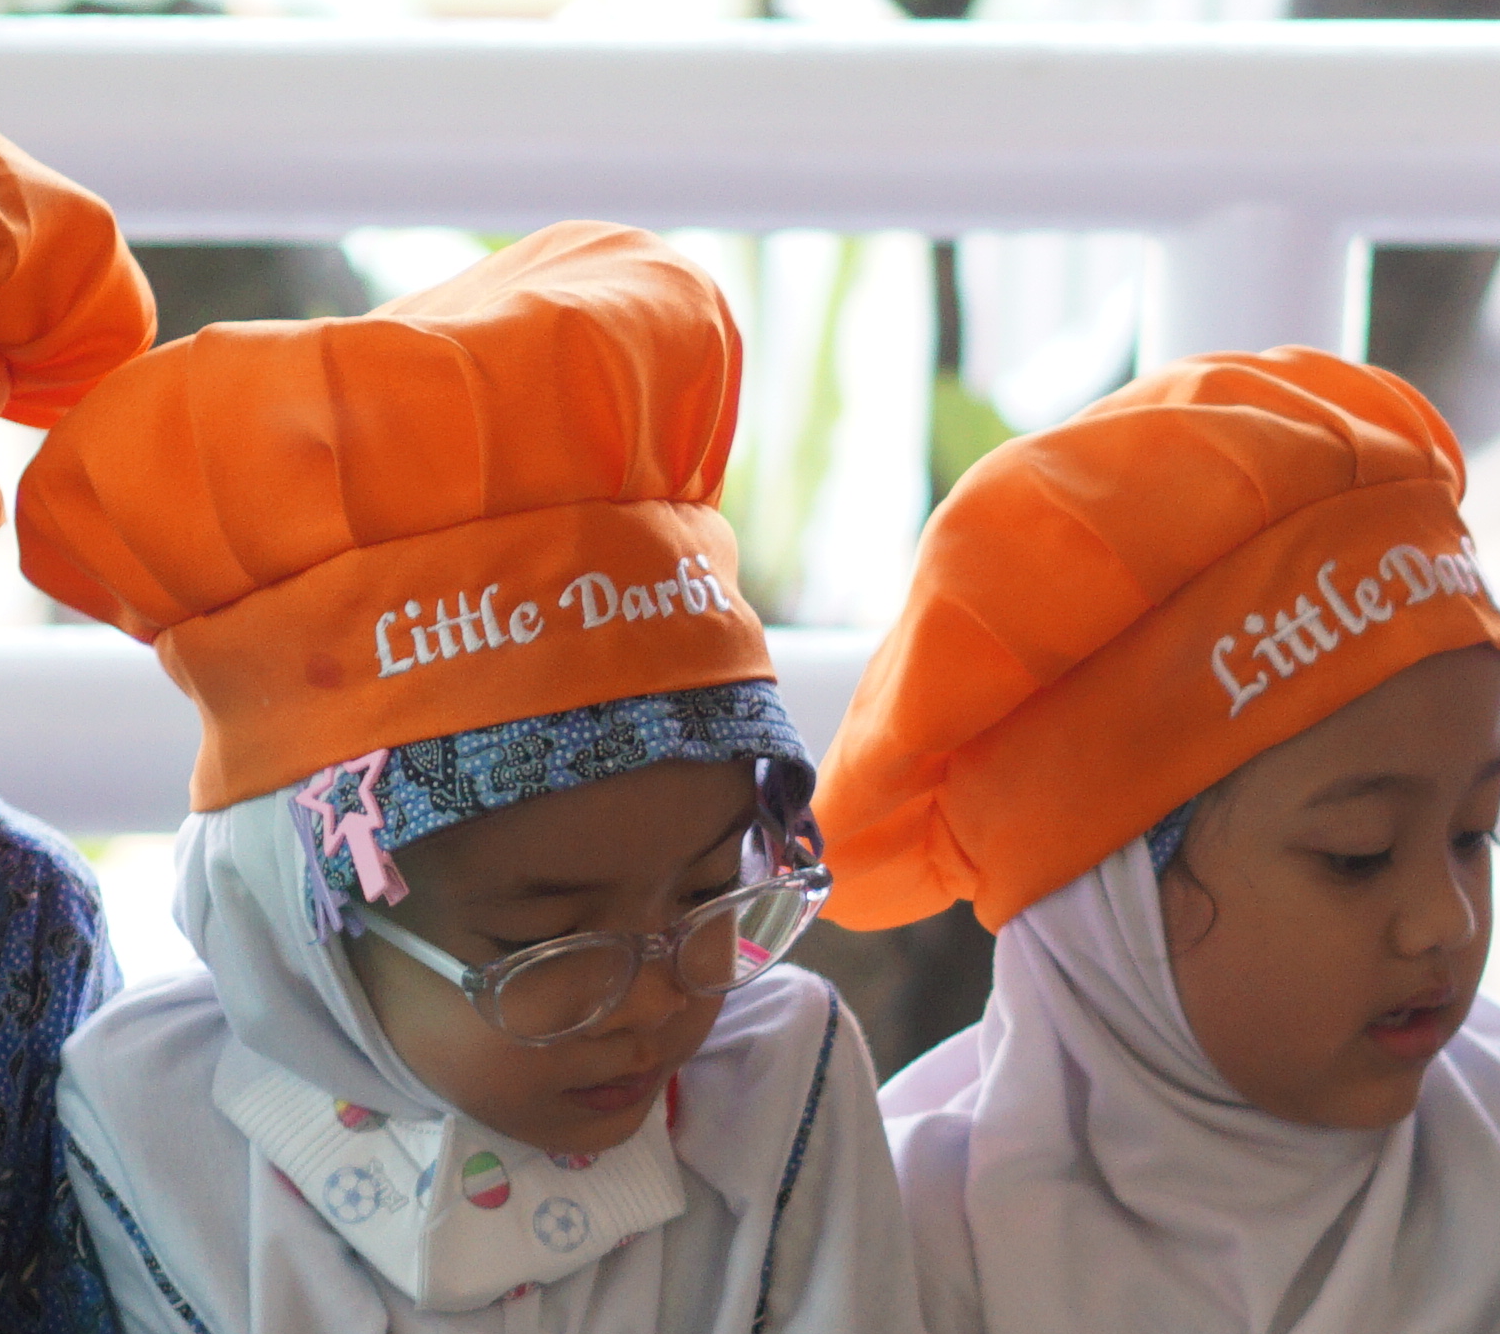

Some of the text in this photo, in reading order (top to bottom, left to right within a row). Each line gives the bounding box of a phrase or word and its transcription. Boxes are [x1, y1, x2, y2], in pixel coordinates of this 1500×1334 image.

[375, 553, 731, 678] Little Darbi
[1210, 560, 1393, 717] Little
